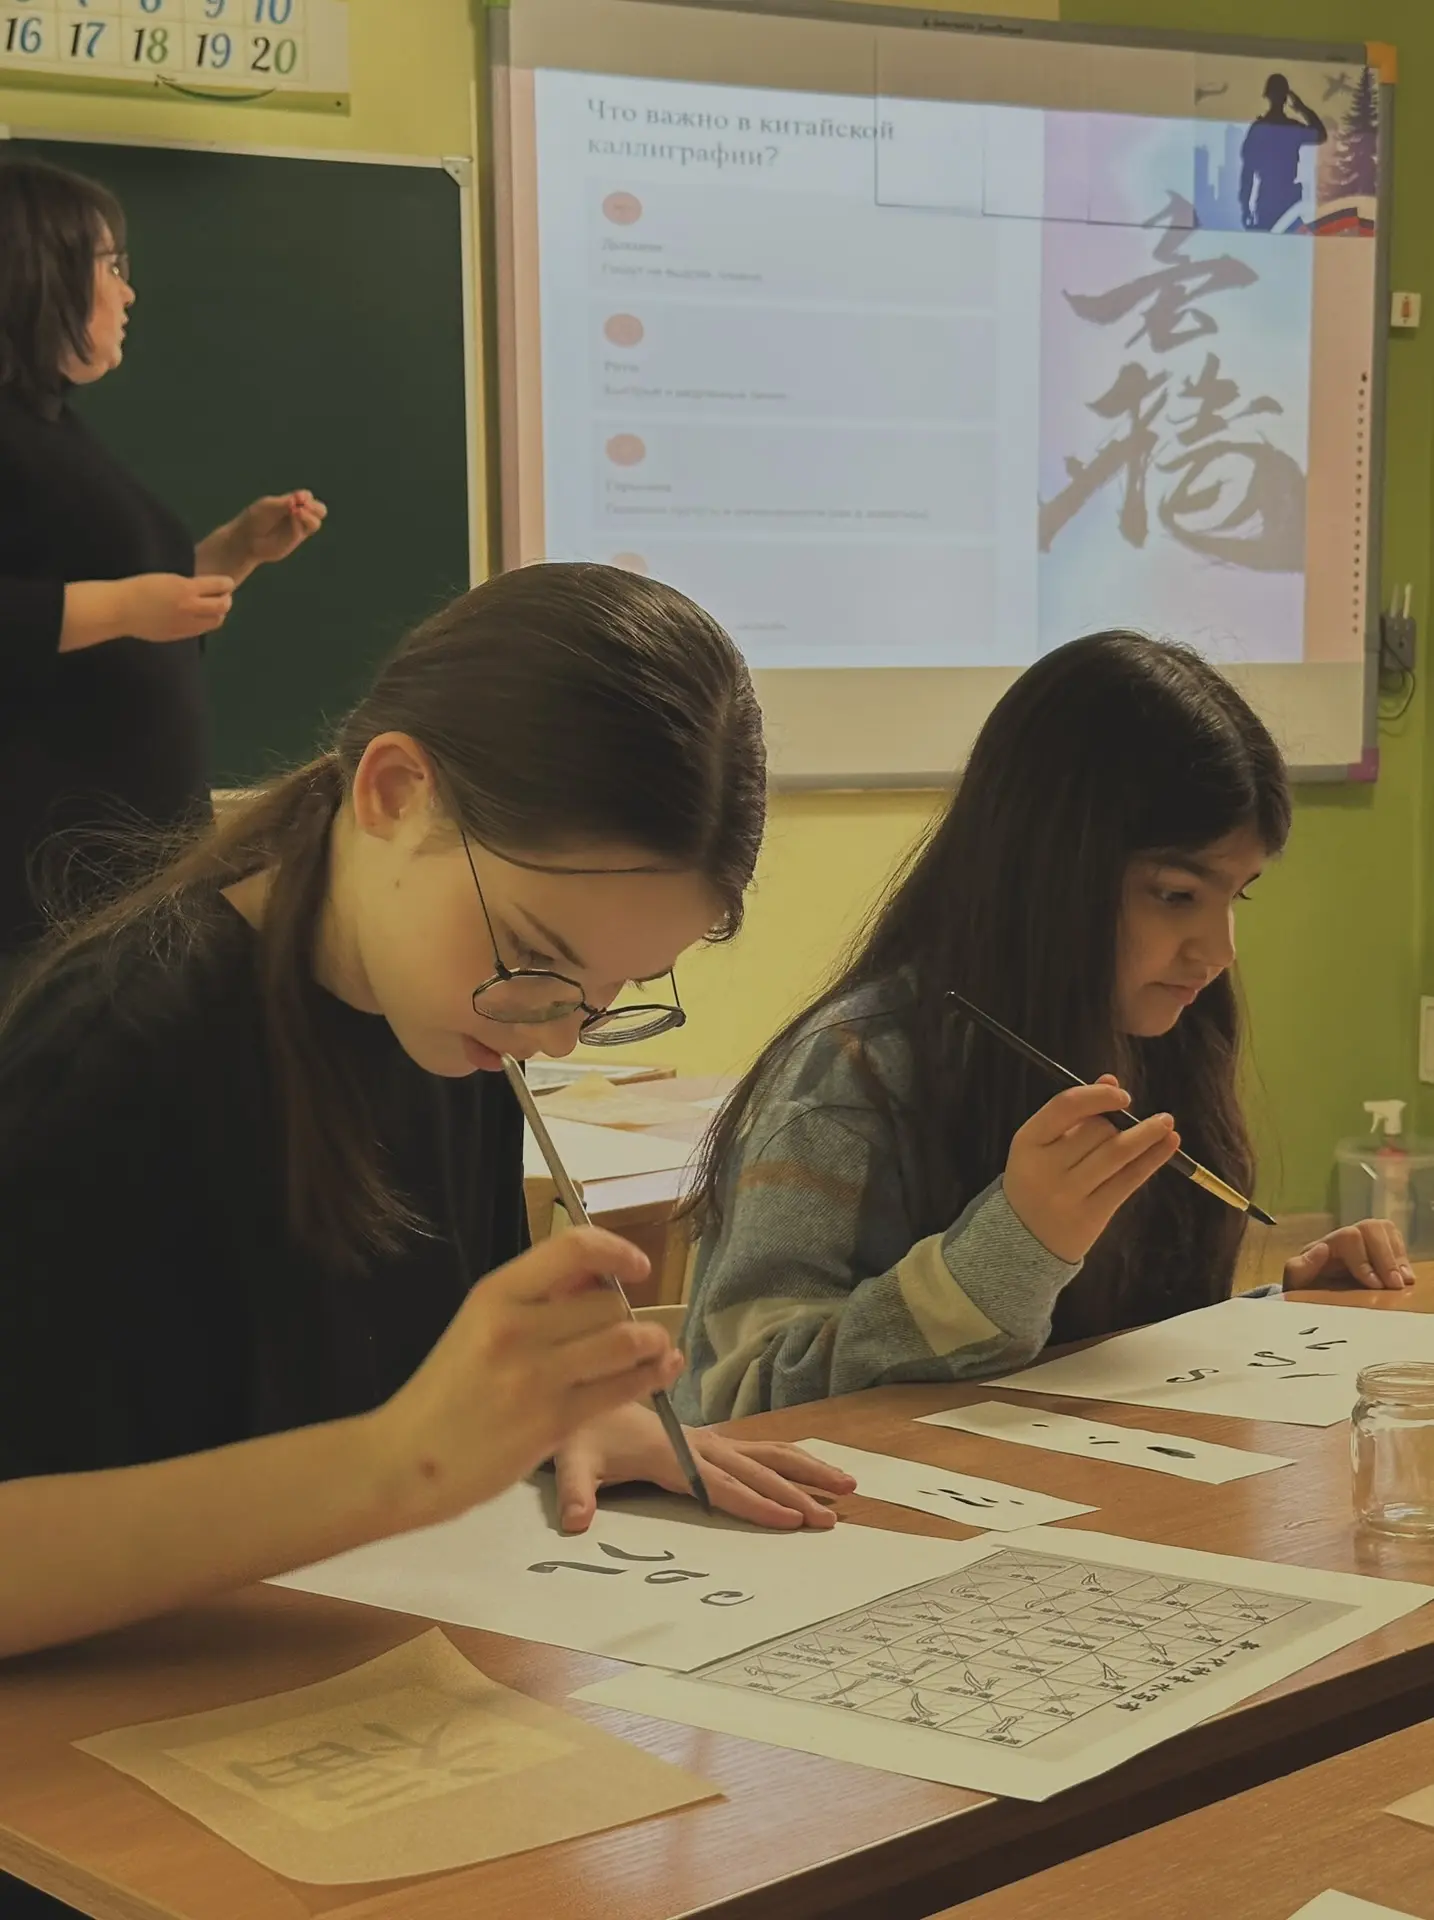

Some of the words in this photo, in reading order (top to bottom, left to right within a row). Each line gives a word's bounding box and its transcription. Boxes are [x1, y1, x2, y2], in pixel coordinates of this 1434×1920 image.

[5, 17, 42, 53] 16
[69, 22, 107, 58] 17
[133, 27, 169, 64] 18
[196, 32, 232, 69] 19
[250, 36, 297, 75] 20
[587, 98, 638, 123] Что
[645, 106, 729, 130] важно
[738, 115, 751, 131] в
[759, 118, 895, 141] китайской
[587, 138, 780, 169] каллиграфии?
